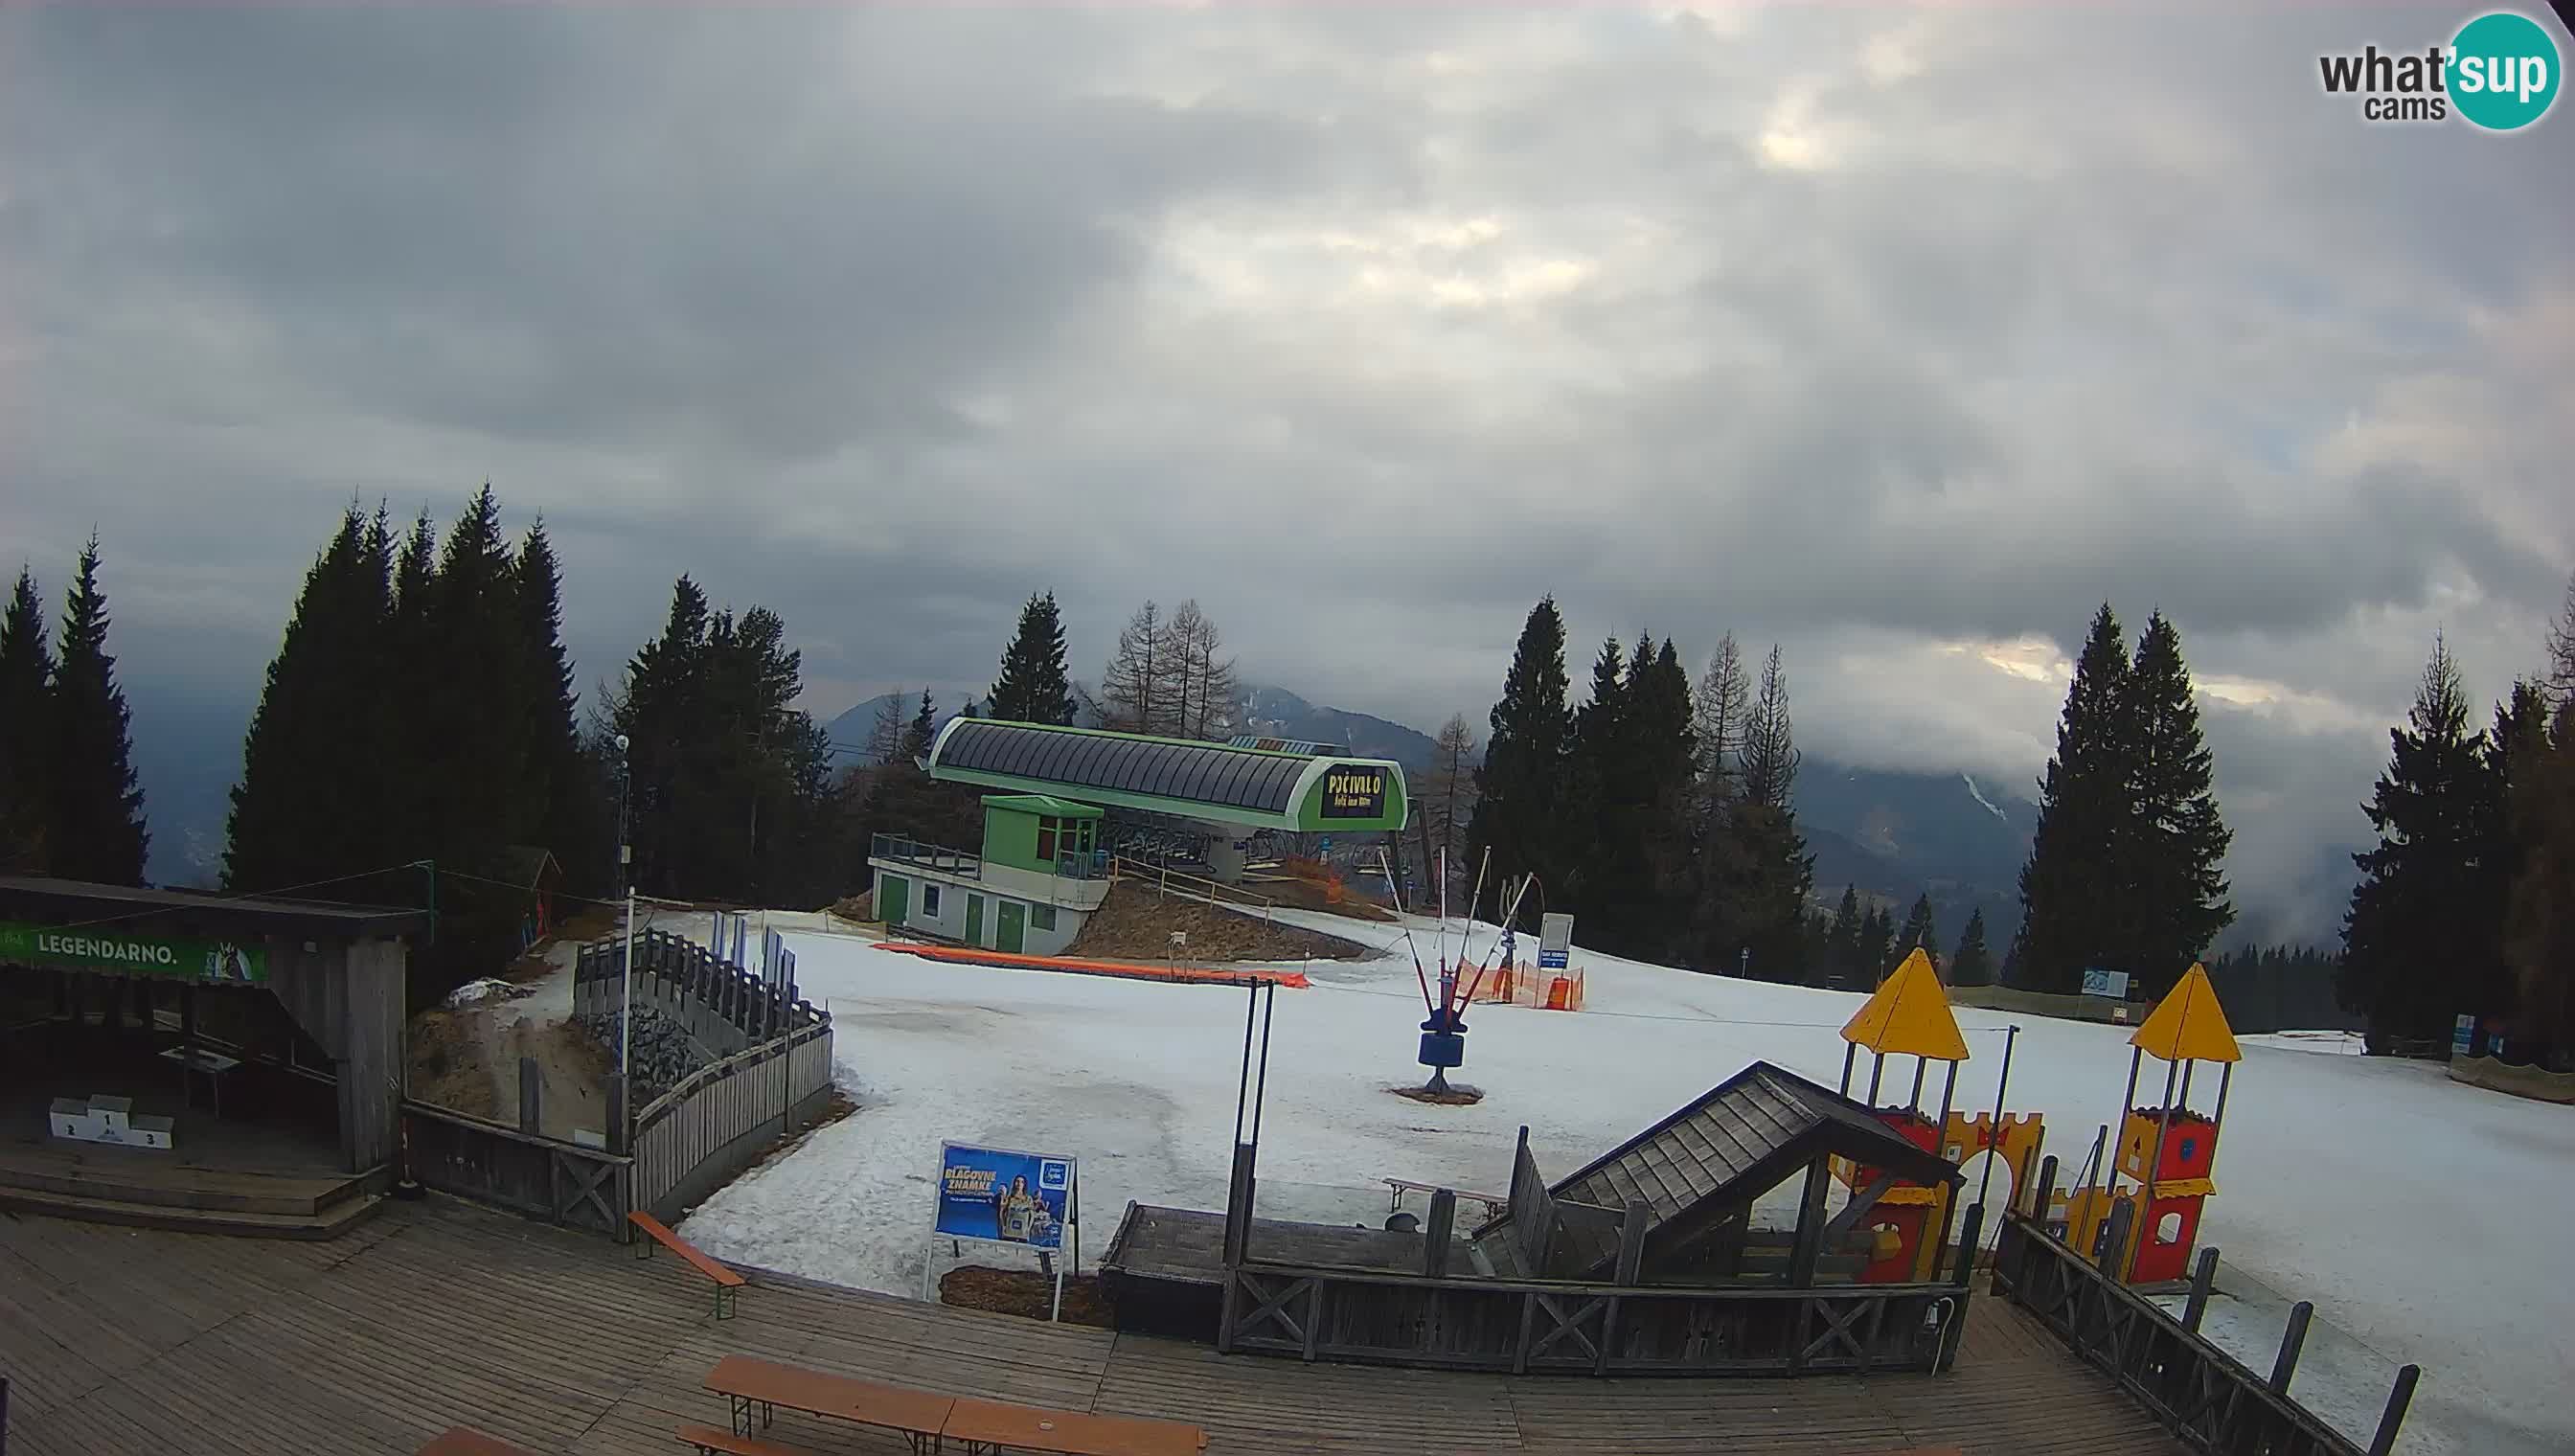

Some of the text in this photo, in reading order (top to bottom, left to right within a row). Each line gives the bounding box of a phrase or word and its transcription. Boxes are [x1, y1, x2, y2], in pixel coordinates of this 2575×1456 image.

[38, 934, 177, 965] LEGENDARNO.
[104, 1113, 111, 1126] 1
[67, 1124, 76, 1136] 2
[147, 1133, 155, 1146] 3
